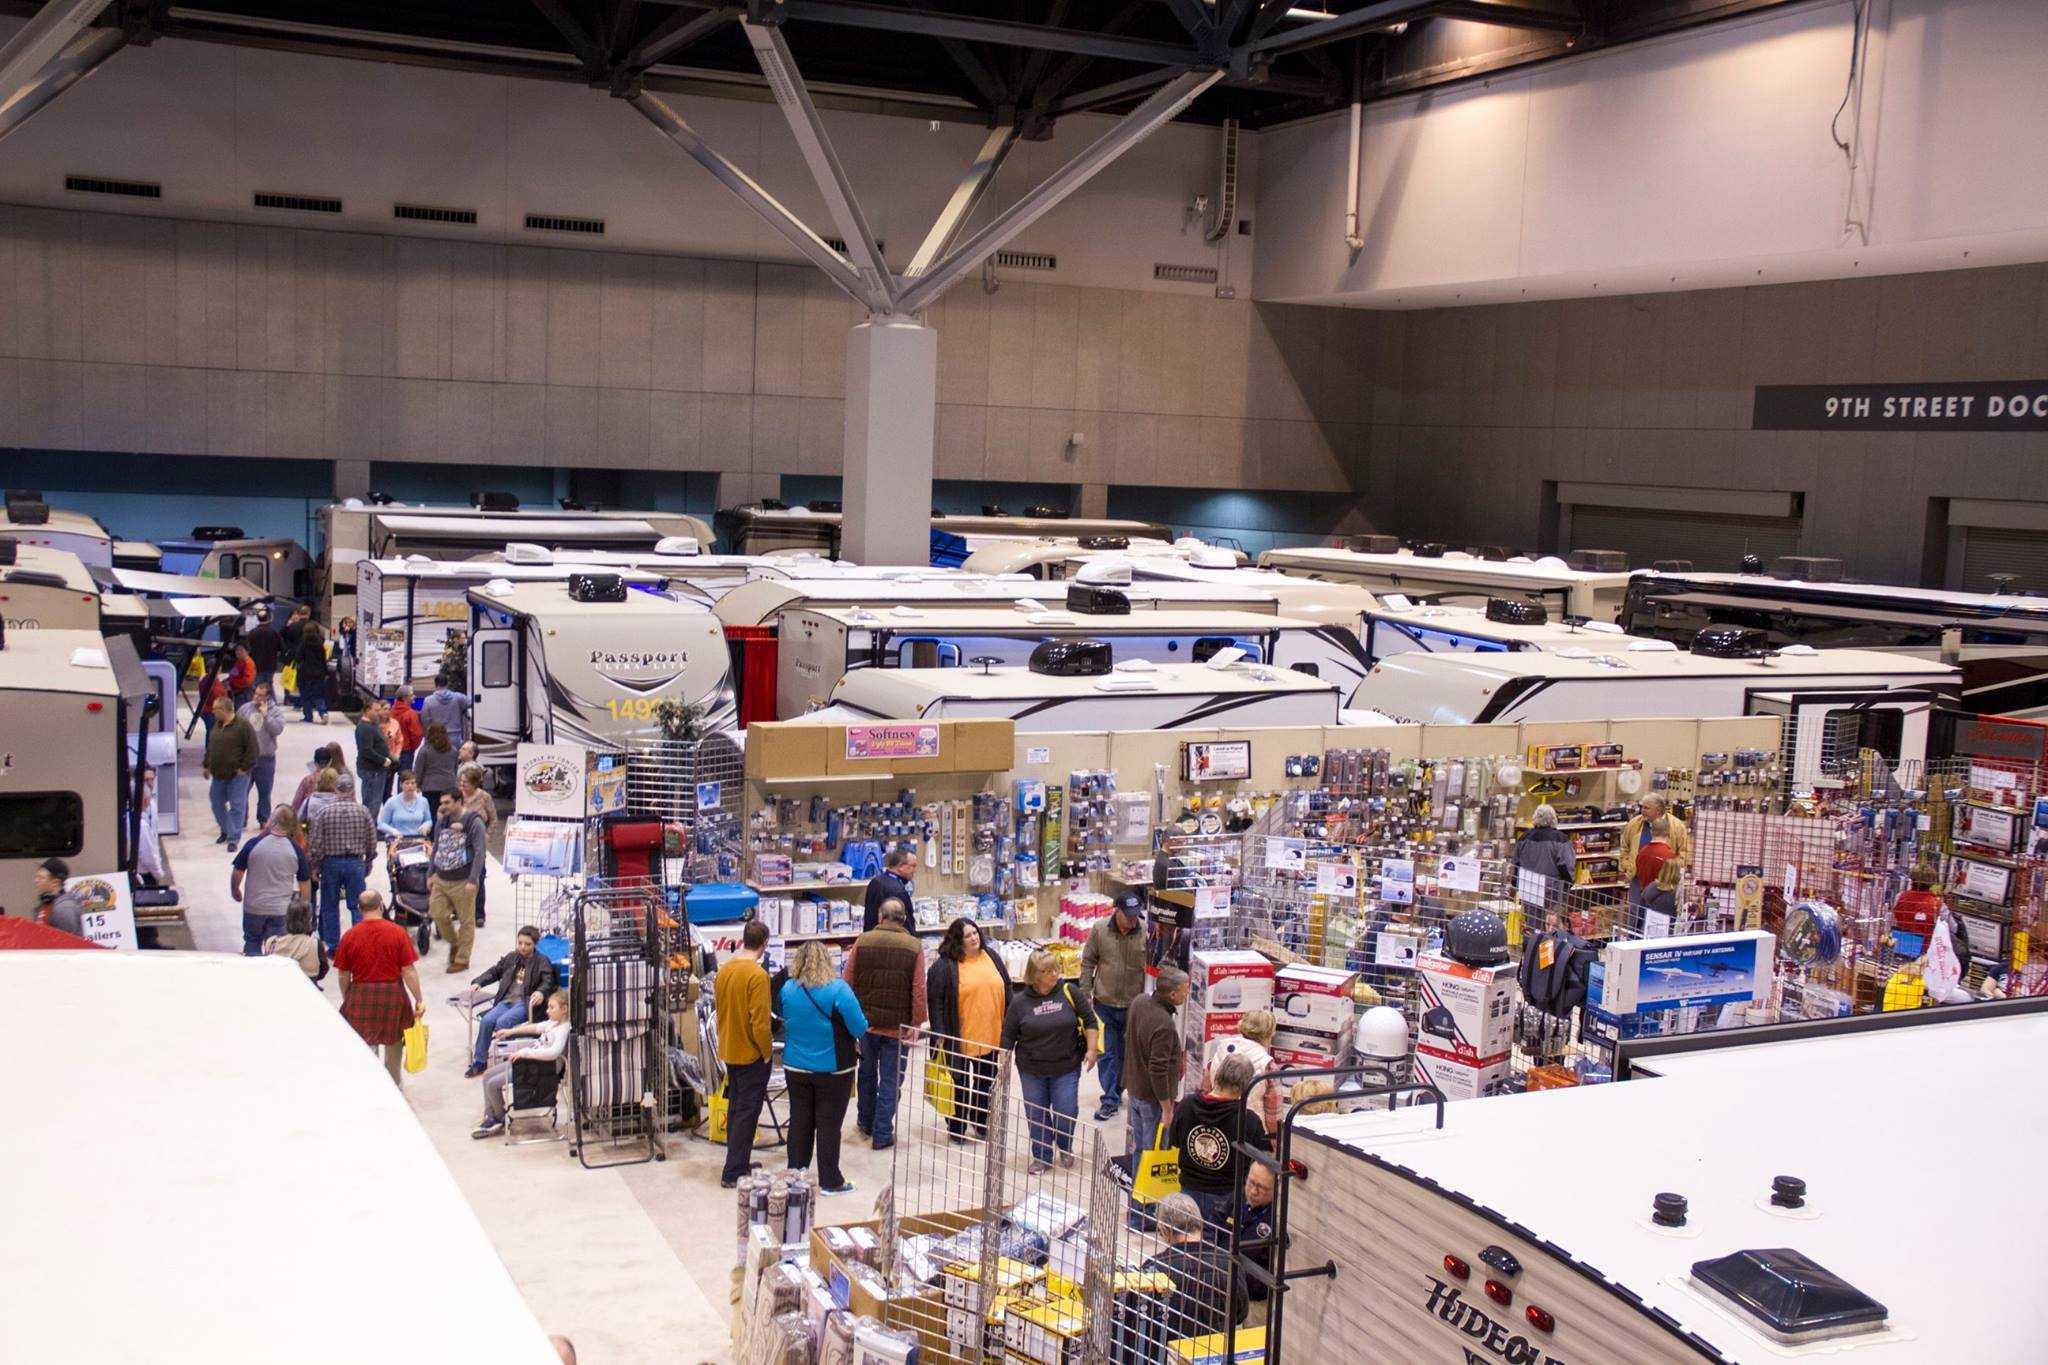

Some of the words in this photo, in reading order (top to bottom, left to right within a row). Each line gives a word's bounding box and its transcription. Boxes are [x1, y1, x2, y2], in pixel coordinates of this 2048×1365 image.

[1825, 397, 1870, 418] 9TH
[1882, 396, 1974, 418] STREET
[590, 650, 689, 666] Passport
[869, 728, 915, 740] Softness
[86, 914, 106, 928] 15
[85, 931, 122, 942] ailers
[1645, 951, 1673, 961] SENSAR
[1674, 949, 1683, 958] IV
[1703, 948, 1712, 956] TV
[1213, 966, 1228, 975] dish
[1472, 969, 1490, 982] dish
[1210, 1023, 1225, 1032] dish
[1457, 1046, 1474, 1057] dish
